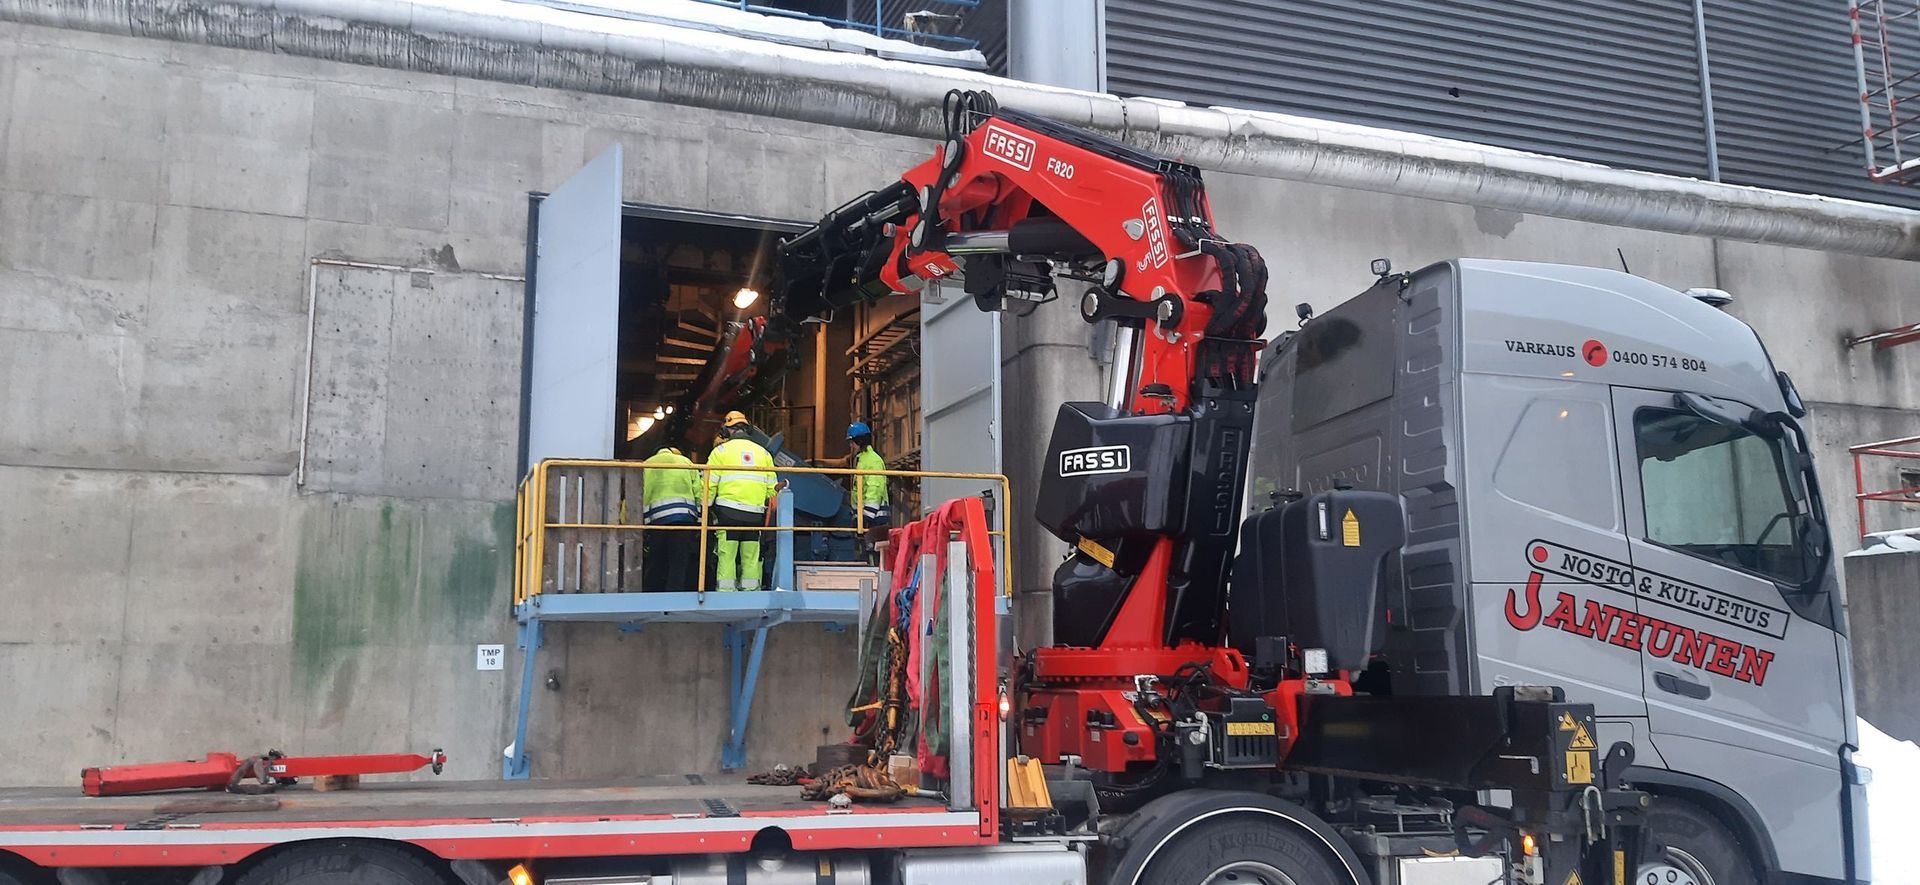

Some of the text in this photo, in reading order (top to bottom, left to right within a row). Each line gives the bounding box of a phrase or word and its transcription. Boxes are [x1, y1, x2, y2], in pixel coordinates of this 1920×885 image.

[988, 132, 1031, 164] FASSI
[1046, 157, 1075, 180] F820
[1145, 205, 1165, 261] FASSI
[1504, 340, 1707, 372] VARKAUS 0400 574 804
[1064, 450, 1123, 472] FASSI
[1560, 553, 1771, 629] NOSTO & KULJETUS
[1504, 571, 1775, 687] JANHUNEN
